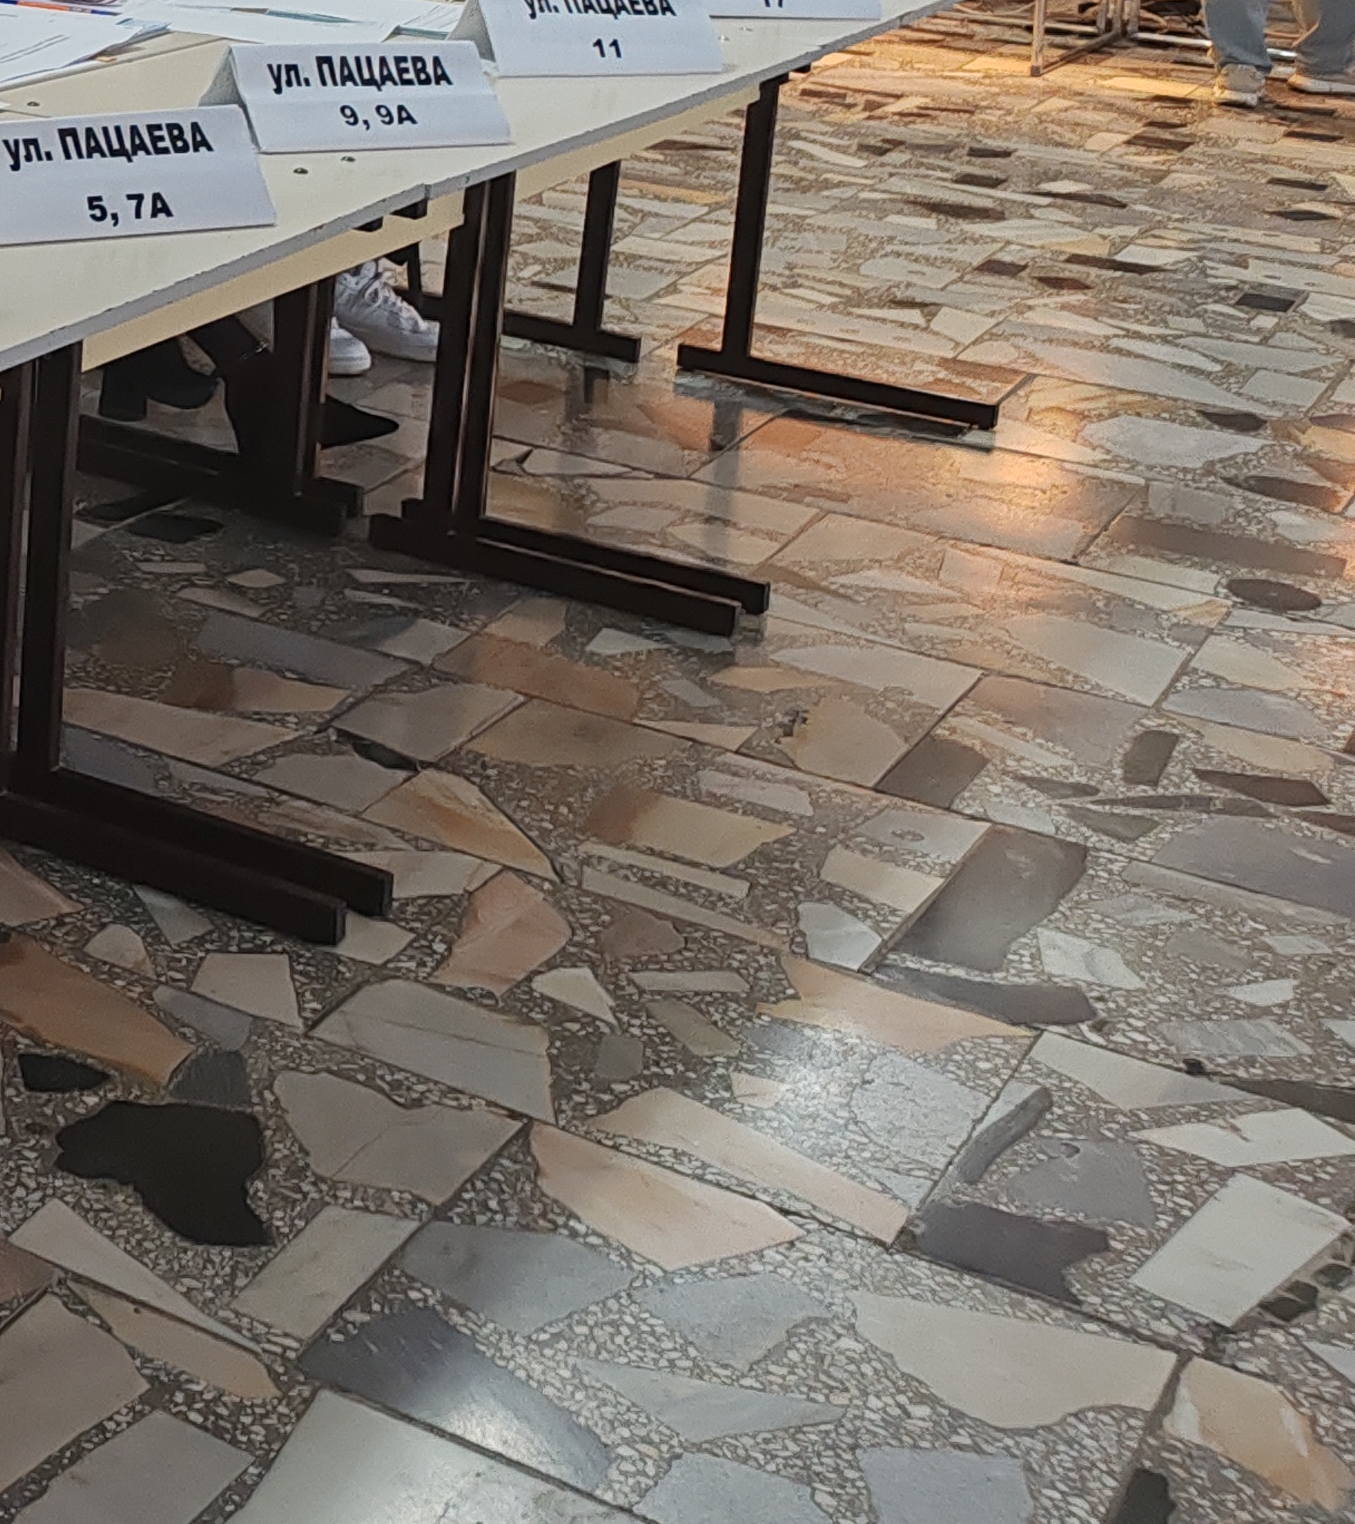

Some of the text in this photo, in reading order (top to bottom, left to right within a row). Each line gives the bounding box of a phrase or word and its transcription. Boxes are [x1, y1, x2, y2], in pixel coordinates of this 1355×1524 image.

[593, 39, 621, 58] 11
[267, 56, 452, 94] ул. ПАЦАЕВА
[340, 105, 417, 130] 9, 9А
[2, 122, 214, 171] ул. ПАЦАЕВА
[87, 192, 173, 227] 5, 7А
